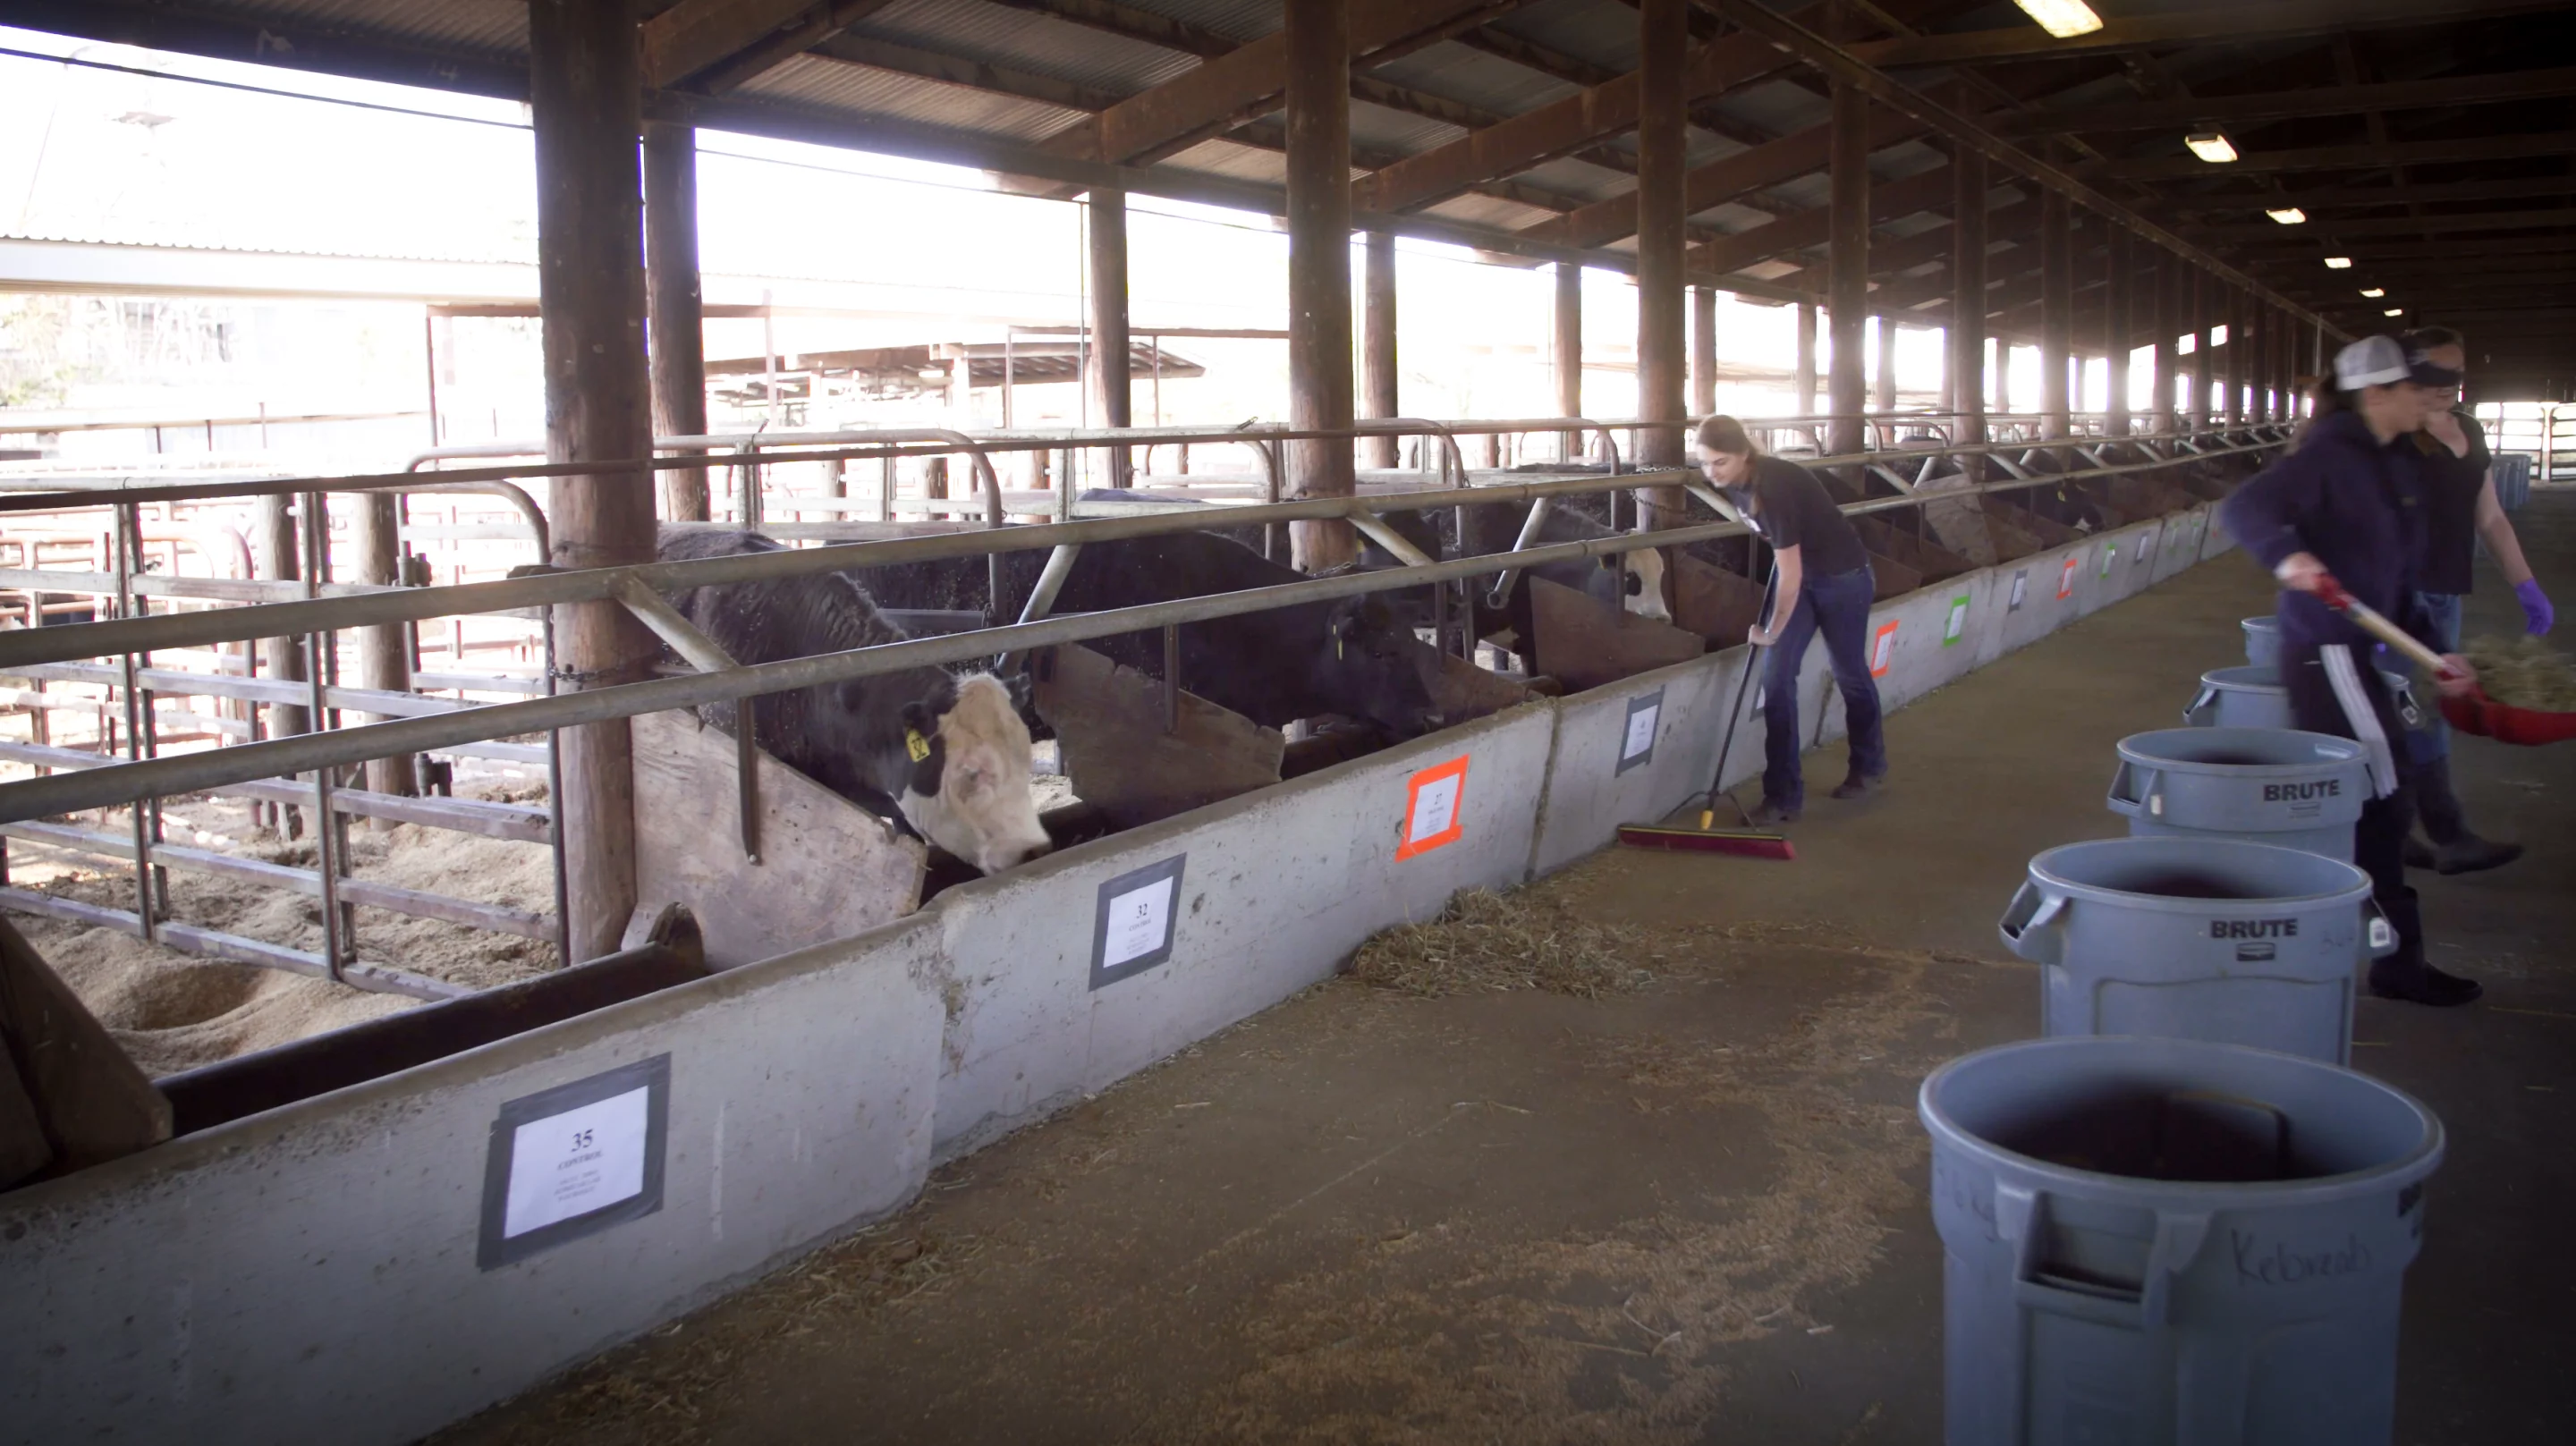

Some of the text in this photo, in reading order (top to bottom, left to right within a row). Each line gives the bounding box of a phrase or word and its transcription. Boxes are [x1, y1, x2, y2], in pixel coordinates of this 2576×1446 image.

[2264, 779, 2341, 801] BRUTE
[1136, 903, 1148, 918] 32
[2210, 918, 2298, 938] BRUTE
[572, 1129, 593, 1152] 35
[557, 1151, 603, 1170] CONTROL
